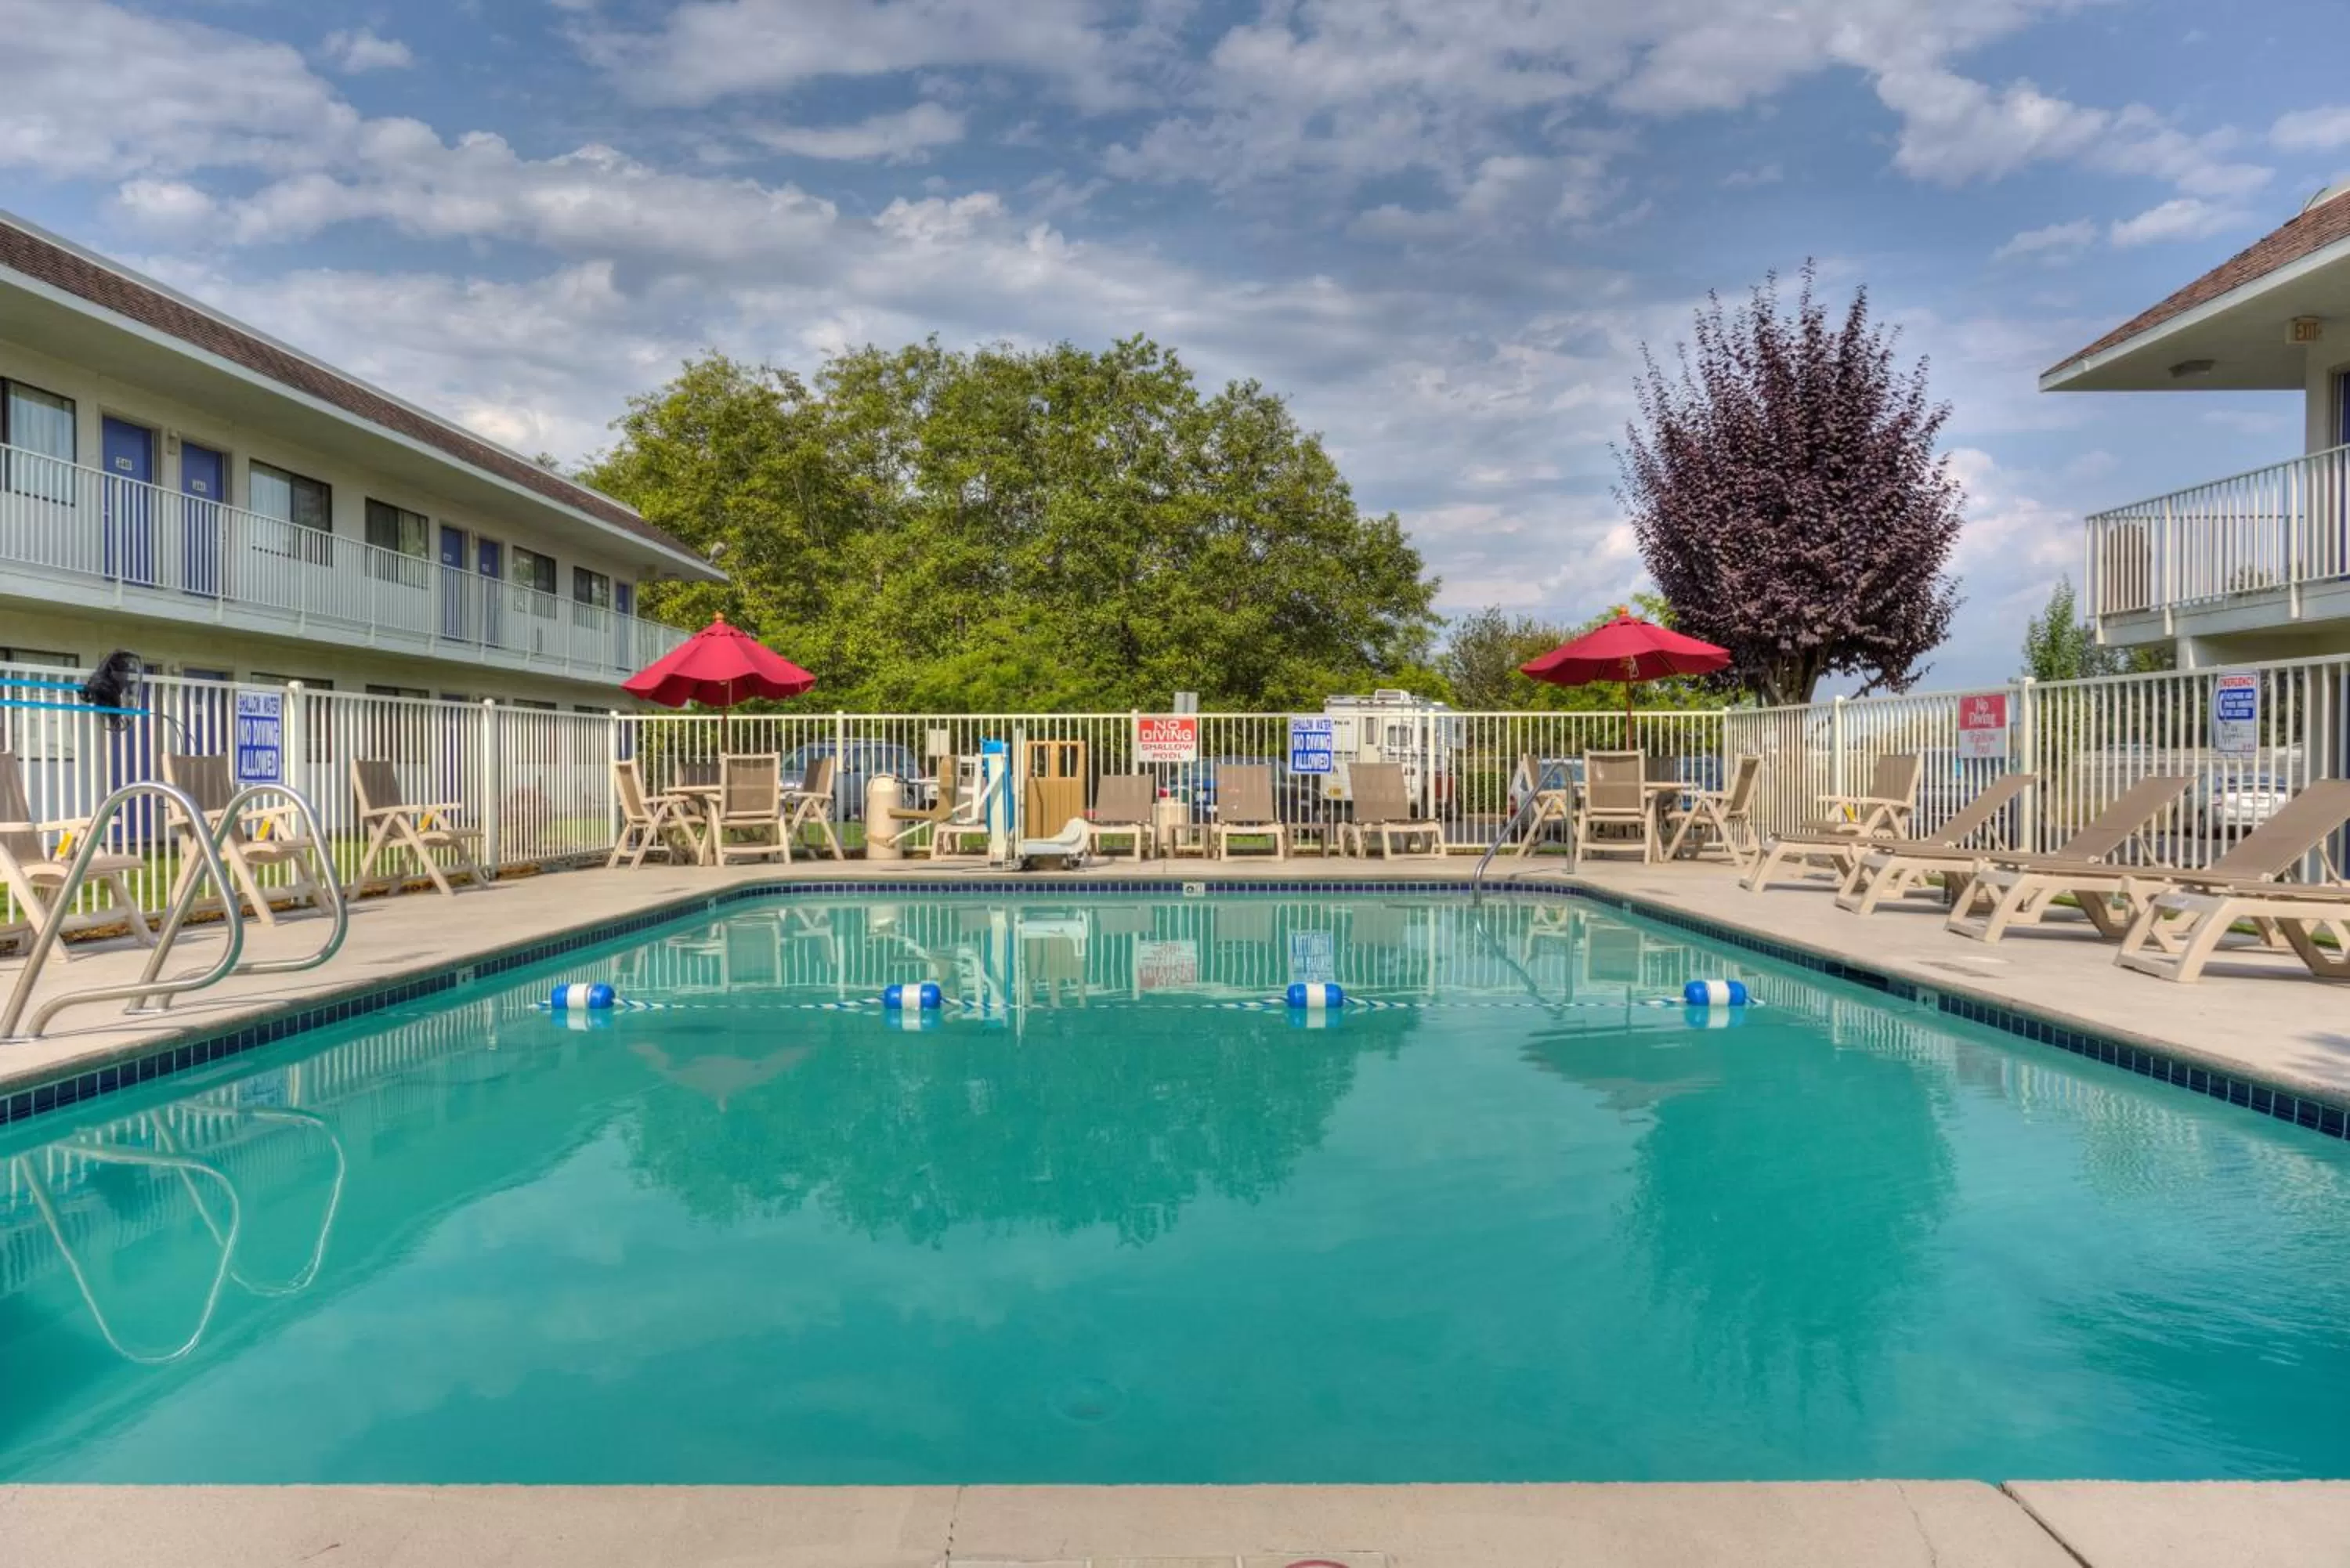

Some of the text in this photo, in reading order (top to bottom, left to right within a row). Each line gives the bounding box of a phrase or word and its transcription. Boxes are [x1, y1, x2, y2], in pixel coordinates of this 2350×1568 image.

[239, 693, 280, 714] SHALLOW WATER
[1975, 697, 1989, 714] No
[1154, 720, 1180, 729] NO
[1969, 712, 1996, 728] Diving
[239, 719, 279, 747] NO DIVING
[1141, 728, 1193, 741] DIVING
[1293, 734, 1331, 750] NO DIVING
[241, 750, 277, 776] ALLOWED
[1295, 753, 1329, 770] ALLOWED
